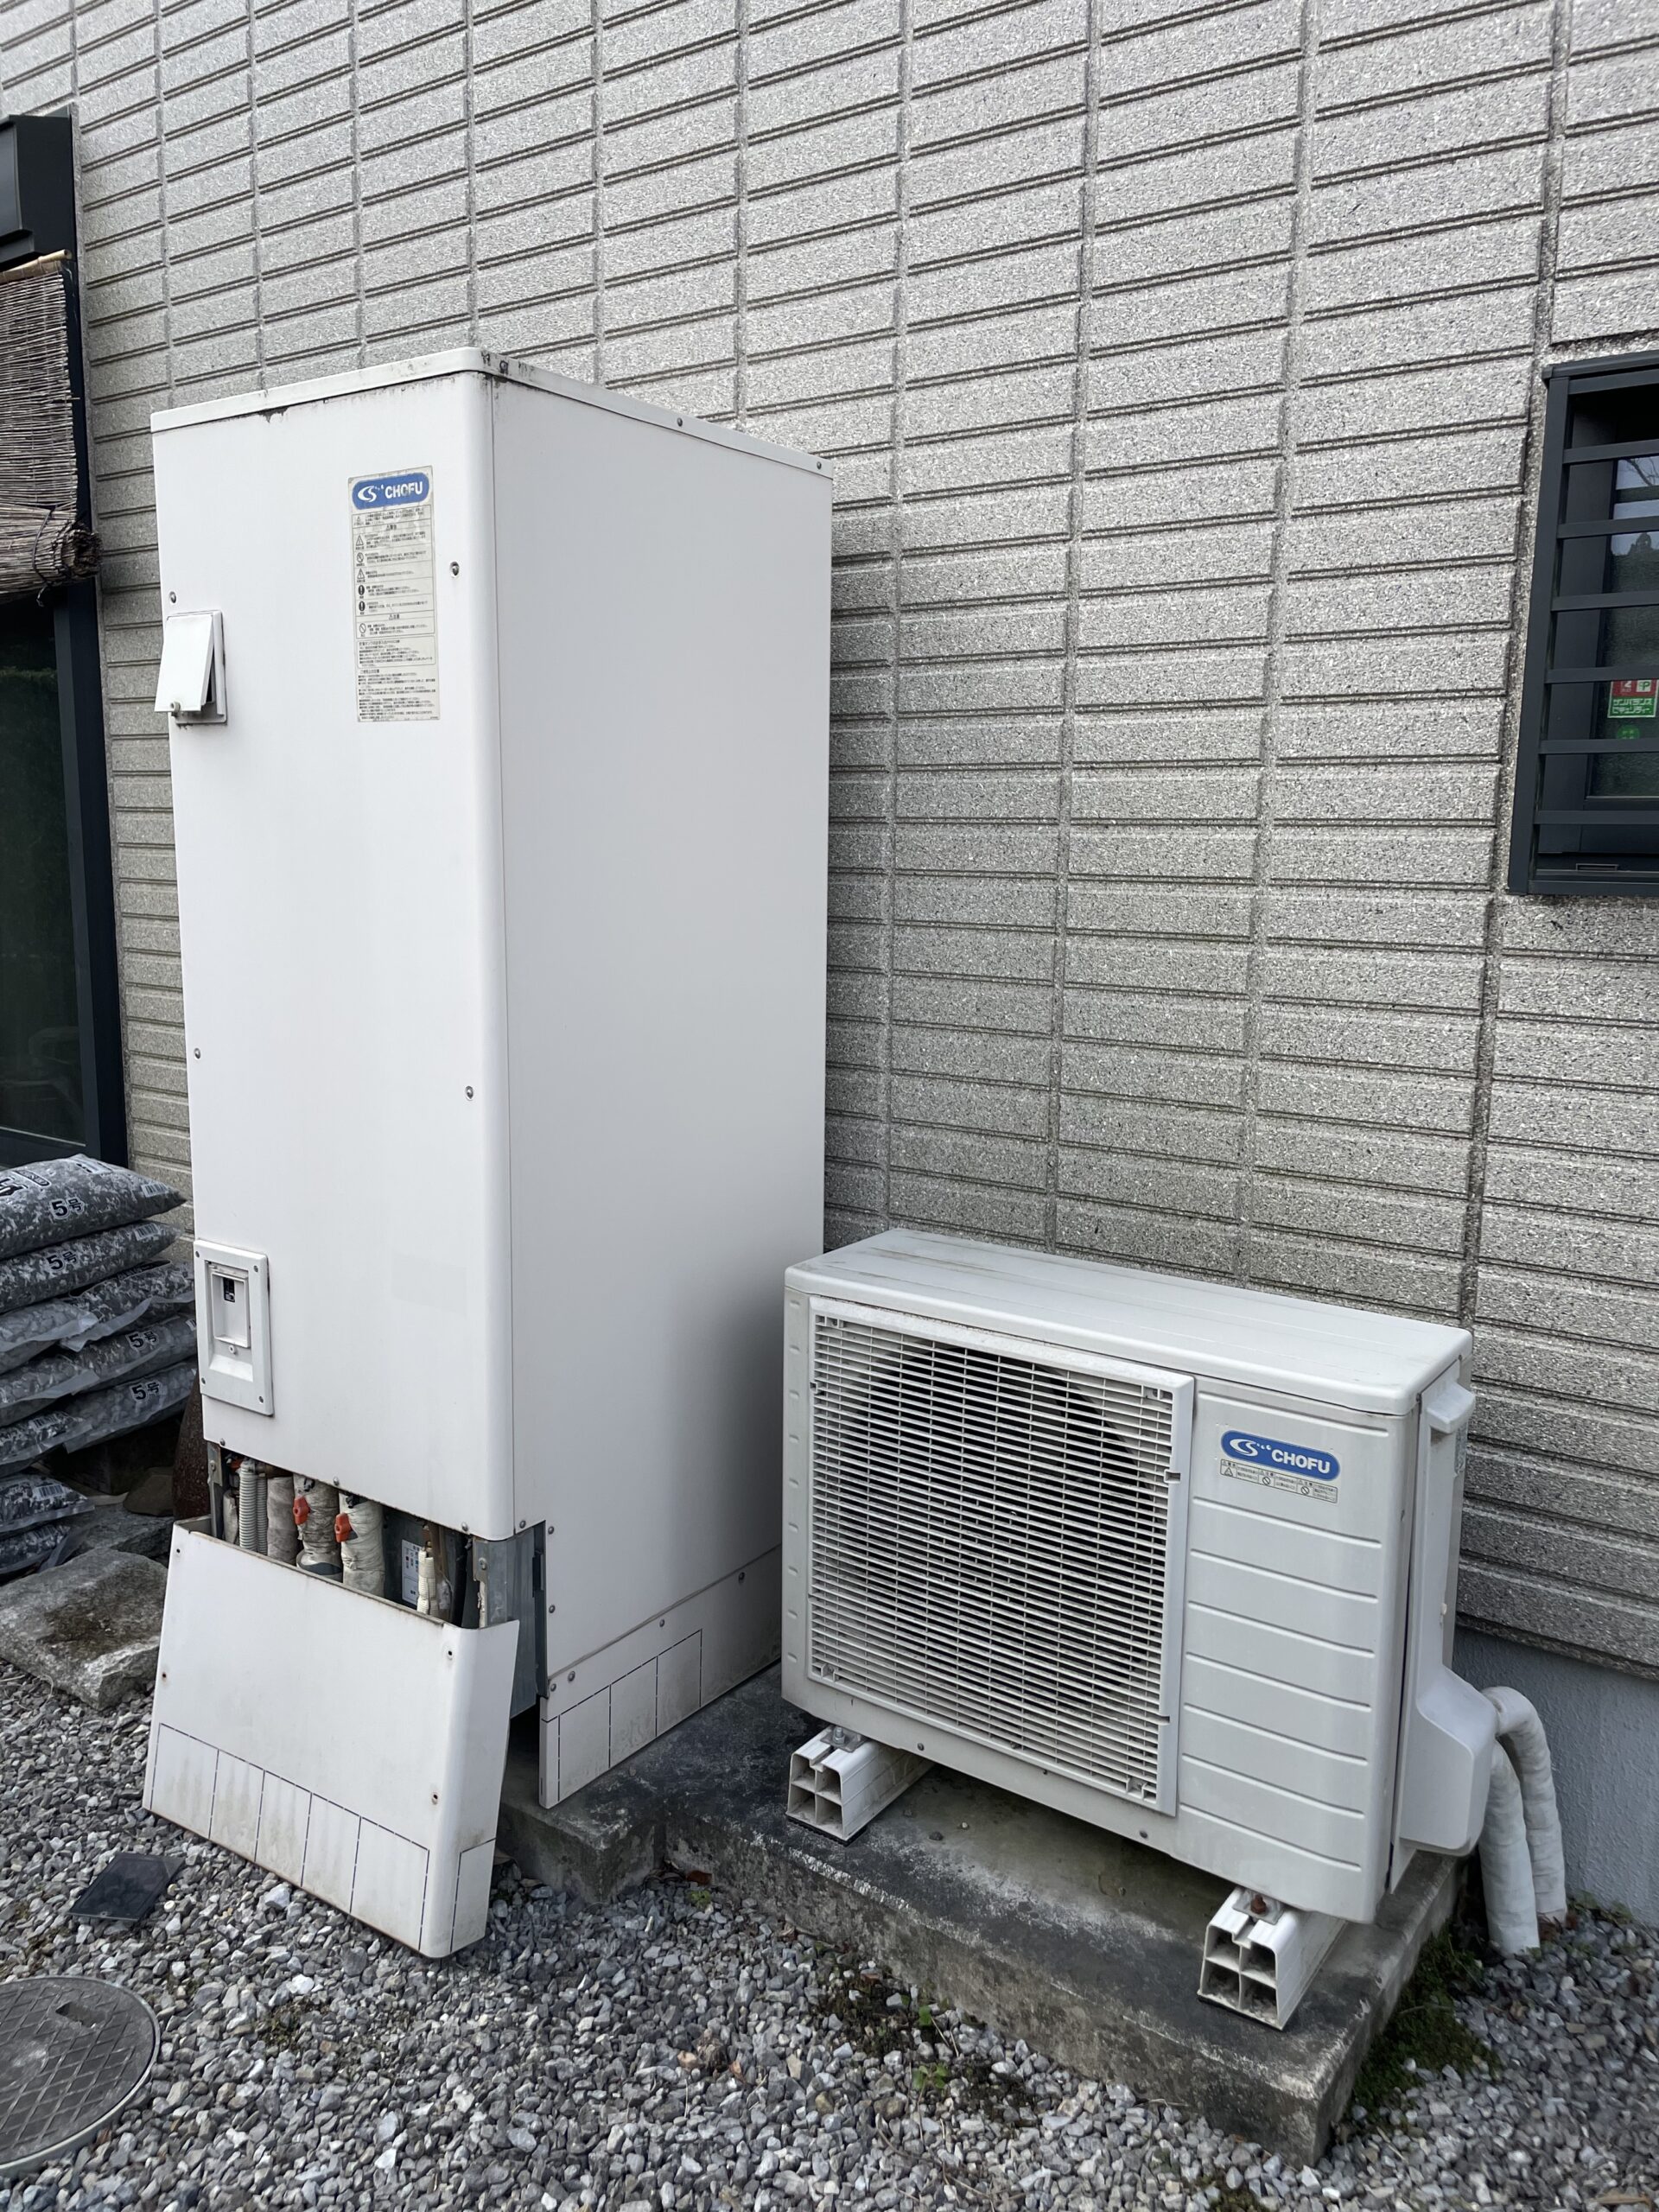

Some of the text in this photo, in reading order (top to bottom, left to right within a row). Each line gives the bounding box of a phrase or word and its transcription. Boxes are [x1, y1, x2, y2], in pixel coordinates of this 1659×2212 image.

[385, 480, 423, 499] CHOFU
[51, 1198, 83, 1217] 5号
[47, 1251, 77, 1271] 5号
[127, 1332, 158, 1349] 5号
[131, 1381, 161, 1402] 5号
[1271, 1448, 1331, 1474] CHOFU
